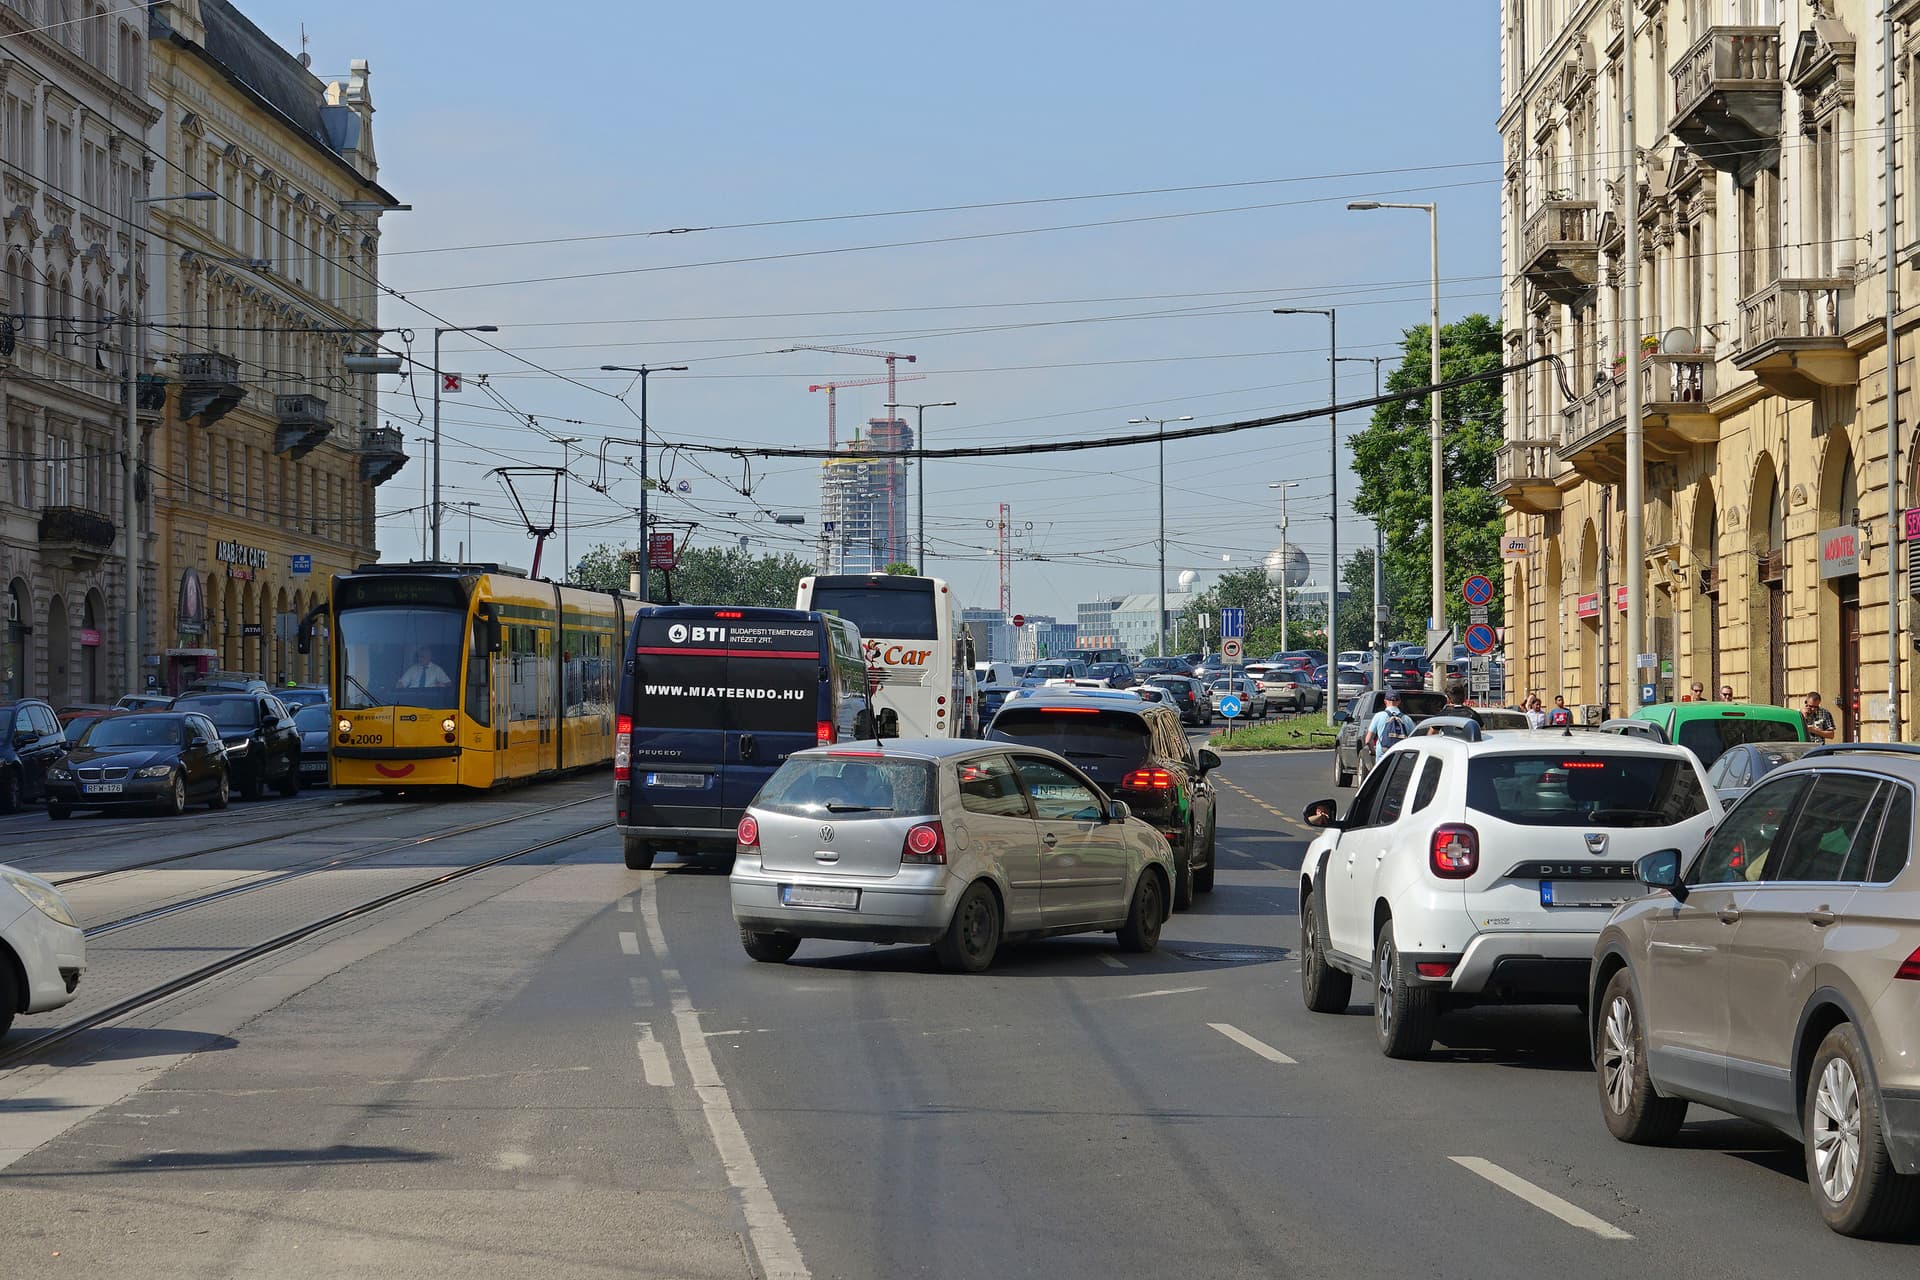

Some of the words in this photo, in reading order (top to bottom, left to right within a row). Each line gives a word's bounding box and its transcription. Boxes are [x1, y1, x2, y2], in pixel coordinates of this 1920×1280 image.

[1509, 541, 1524, 549] dm
[691, 627, 726, 642] BTI
[730, 635, 758, 643] INTÉZET
[884, 645, 932, 666] Car
[148, 675, 156, 685] P
[645, 684, 805, 700] WWW.MIATEENDO.HU
[1643, 687, 1653, 700] P
[356, 734, 383, 745] 2009
[1540, 865, 1632, 874] DUSTE
